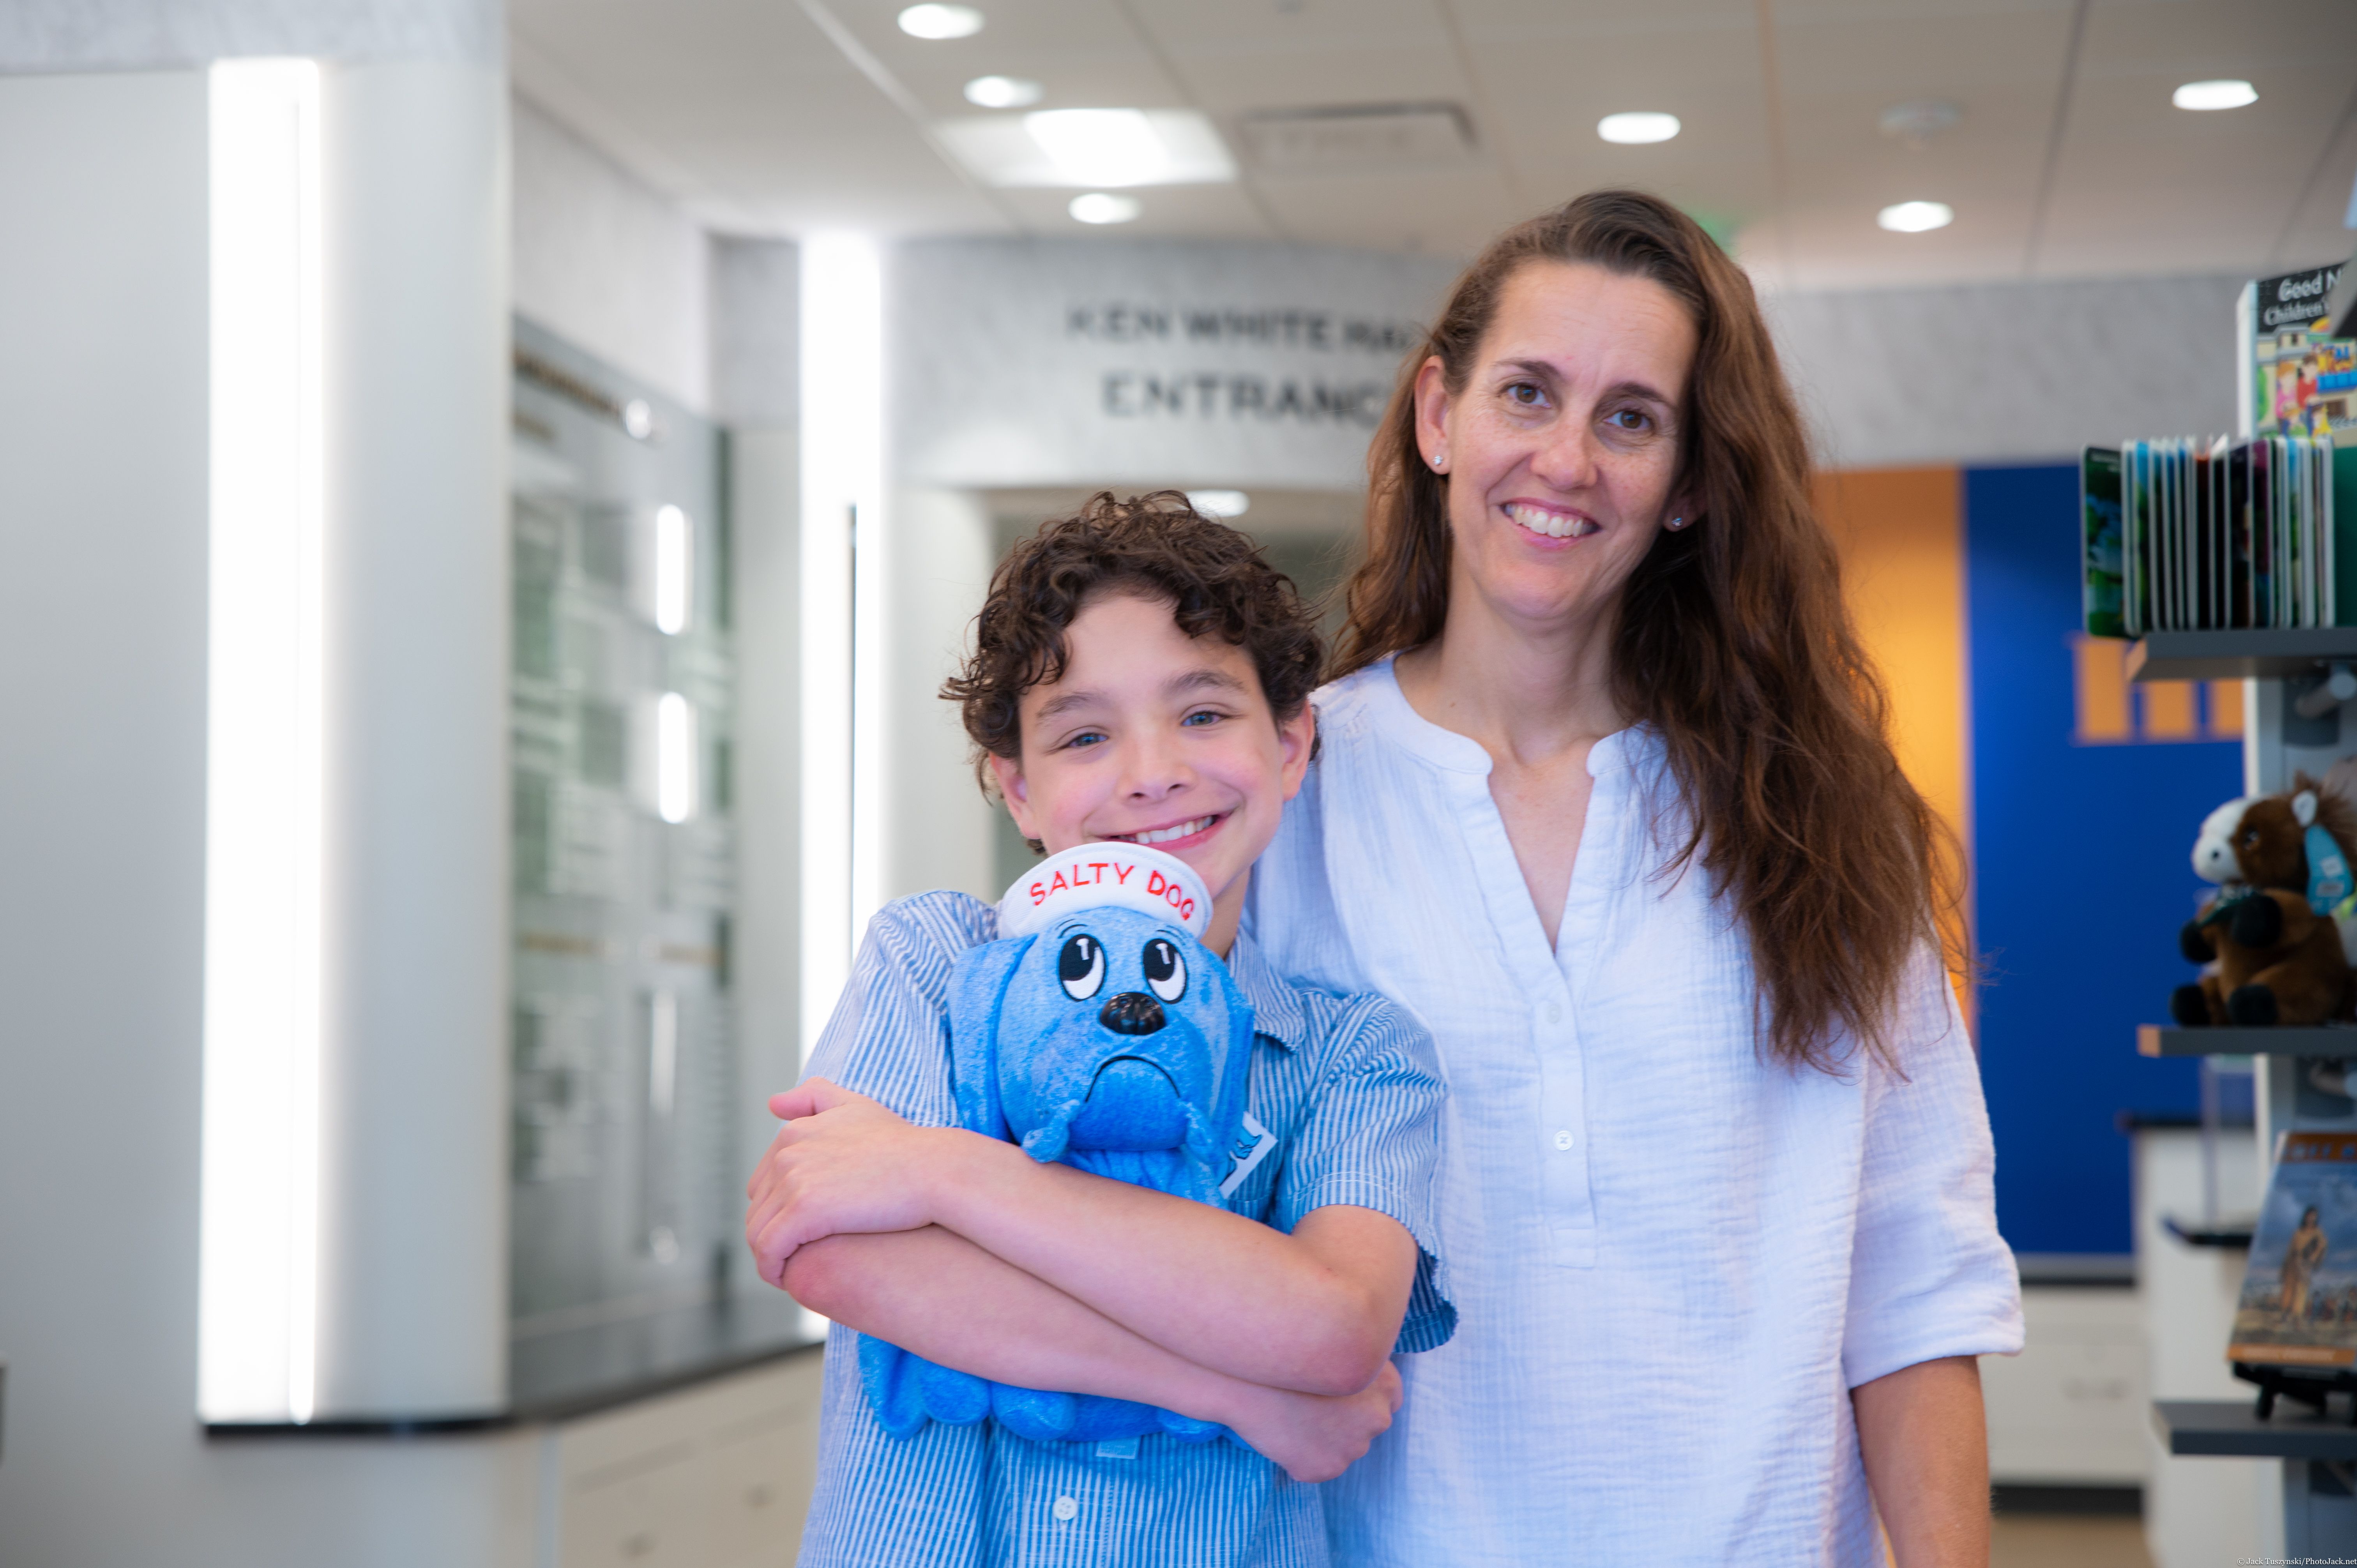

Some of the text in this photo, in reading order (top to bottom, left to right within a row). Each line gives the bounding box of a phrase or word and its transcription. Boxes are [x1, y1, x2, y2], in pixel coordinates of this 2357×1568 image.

[2278, 270, 2323, 302] Good
[1066, 304, 1171, 344] KEN
[1182, 306, 1334, 351] WHITE
[1101, 372, 1388, 429] ENTRANC
[1030, 862, 1194, 921] SALTY DOG
